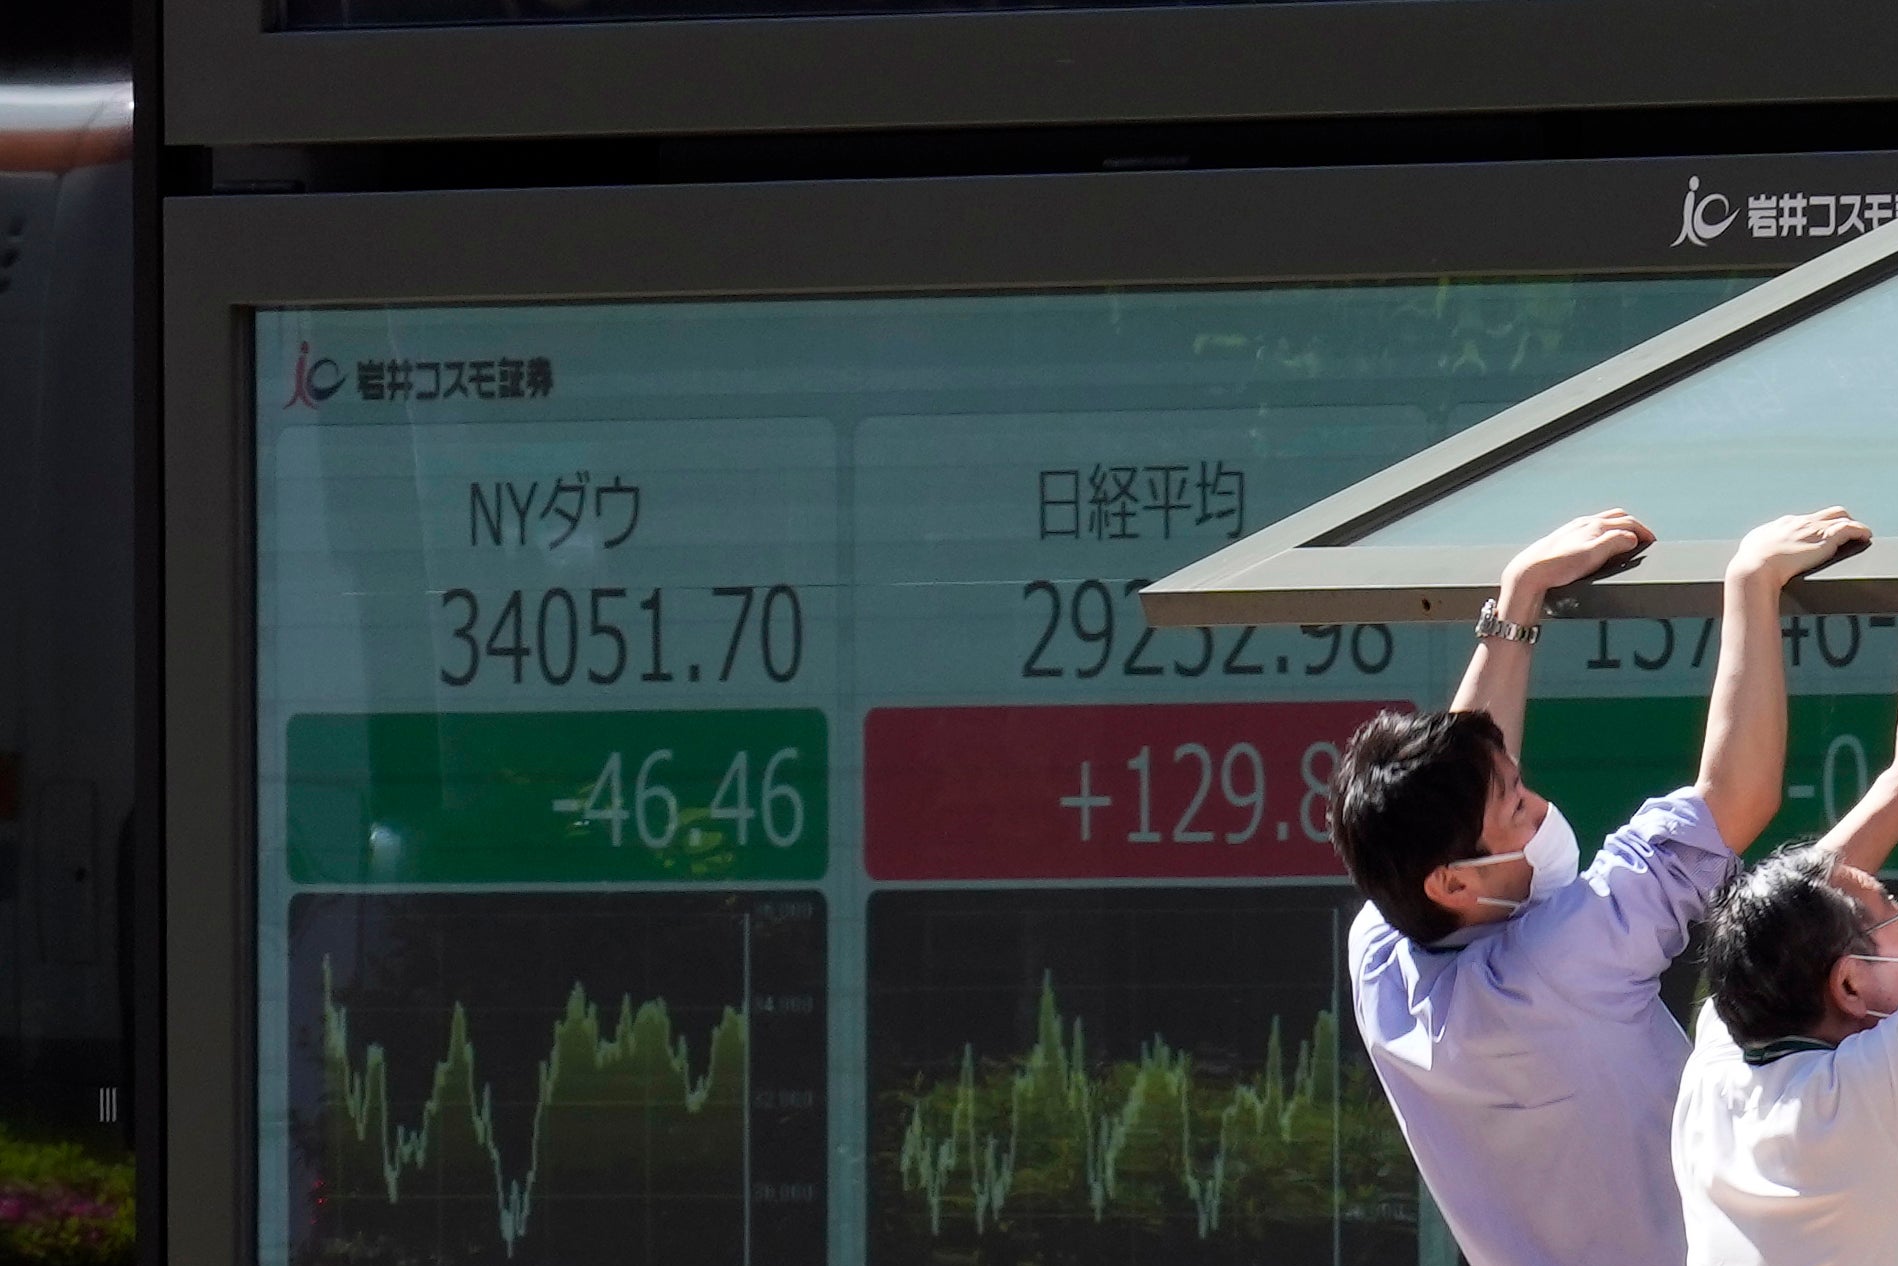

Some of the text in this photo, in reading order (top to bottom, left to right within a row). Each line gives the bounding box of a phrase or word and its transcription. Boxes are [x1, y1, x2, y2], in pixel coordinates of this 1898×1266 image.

[470, 472, 640, 549] NYダウ
[1038, 460, 1245, 541] 日経平均
[440, 584, 802, 686] 34051.70
[552, 747, 804, 848] -46.46
